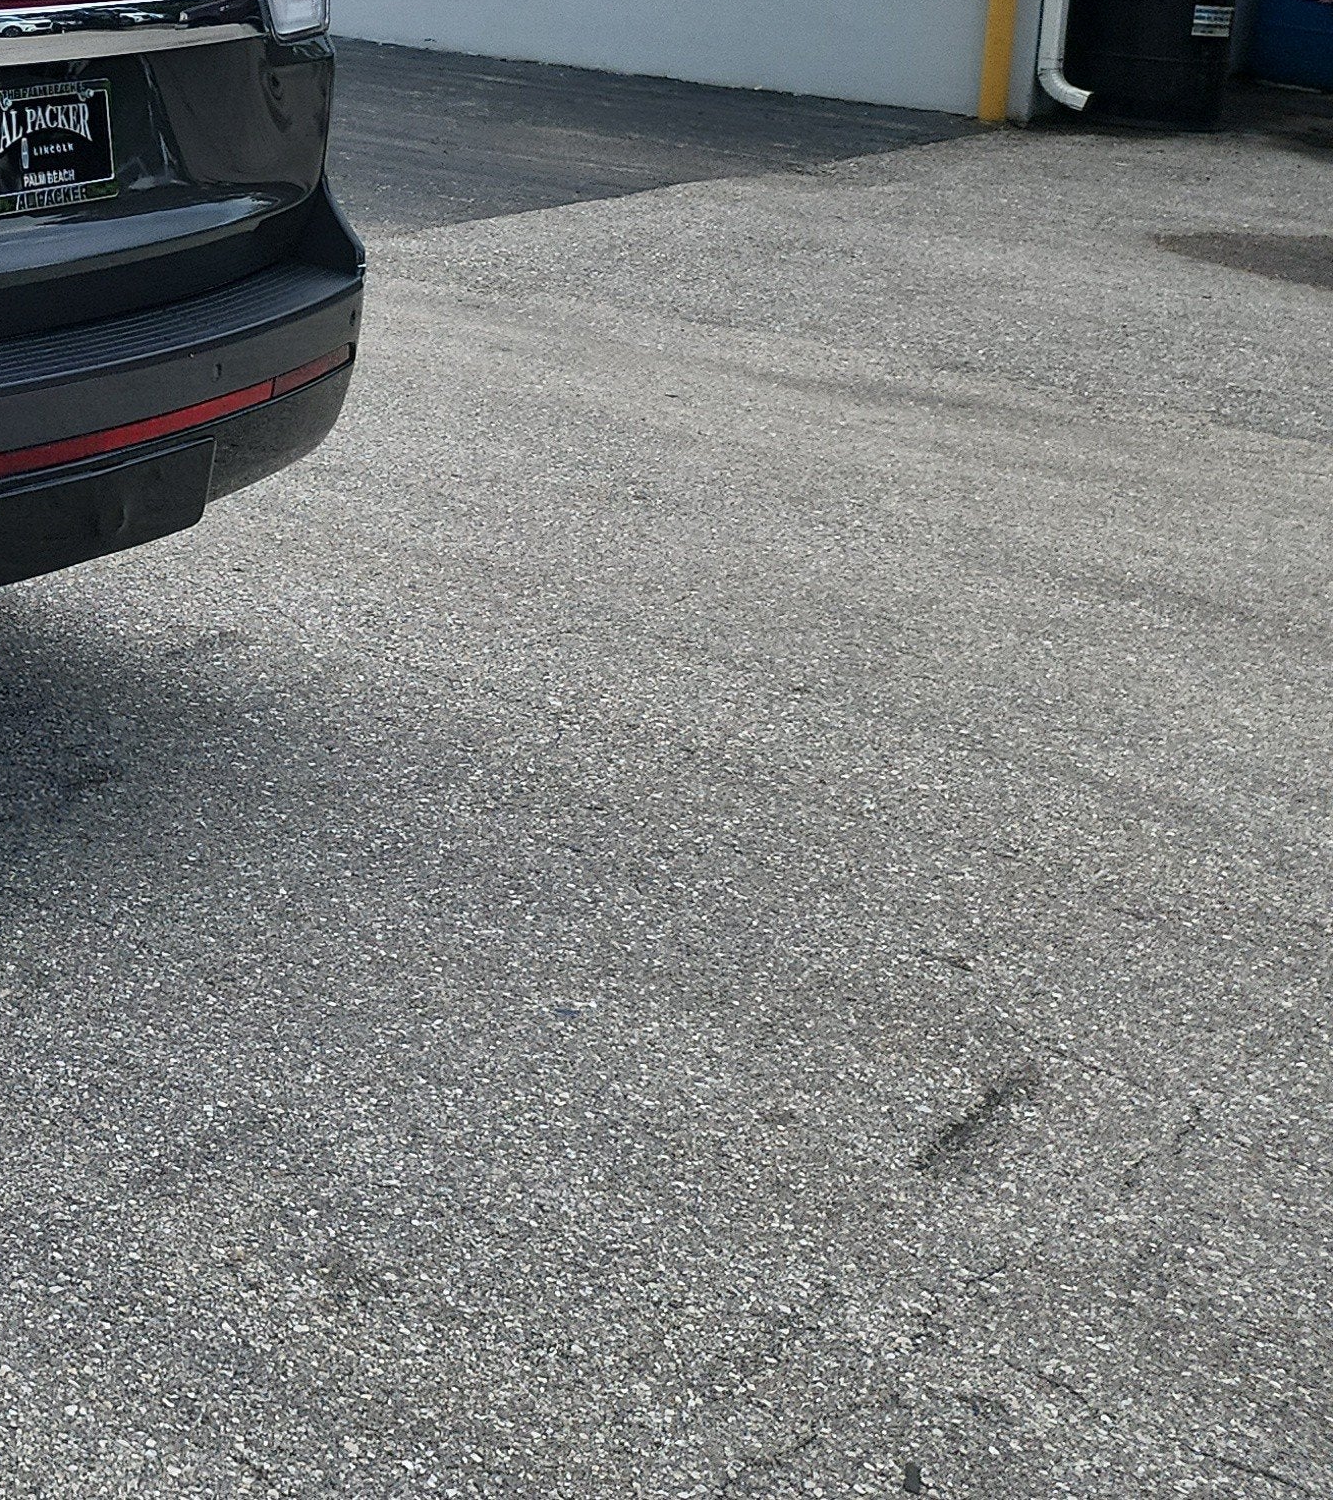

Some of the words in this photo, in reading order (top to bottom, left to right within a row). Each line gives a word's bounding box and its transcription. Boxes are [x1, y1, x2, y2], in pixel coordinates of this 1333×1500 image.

[0, 109, 23, 153] AL
[25, 103, 92, 141] PACKER
[33, 143, 73, 156] LINCOLN
[23, 172, 46, 187] PALM
[47, 169, 75, 184] BEACH
[16, 192, 33, 211] AL
[34, 186, 87, 207] PACKER
